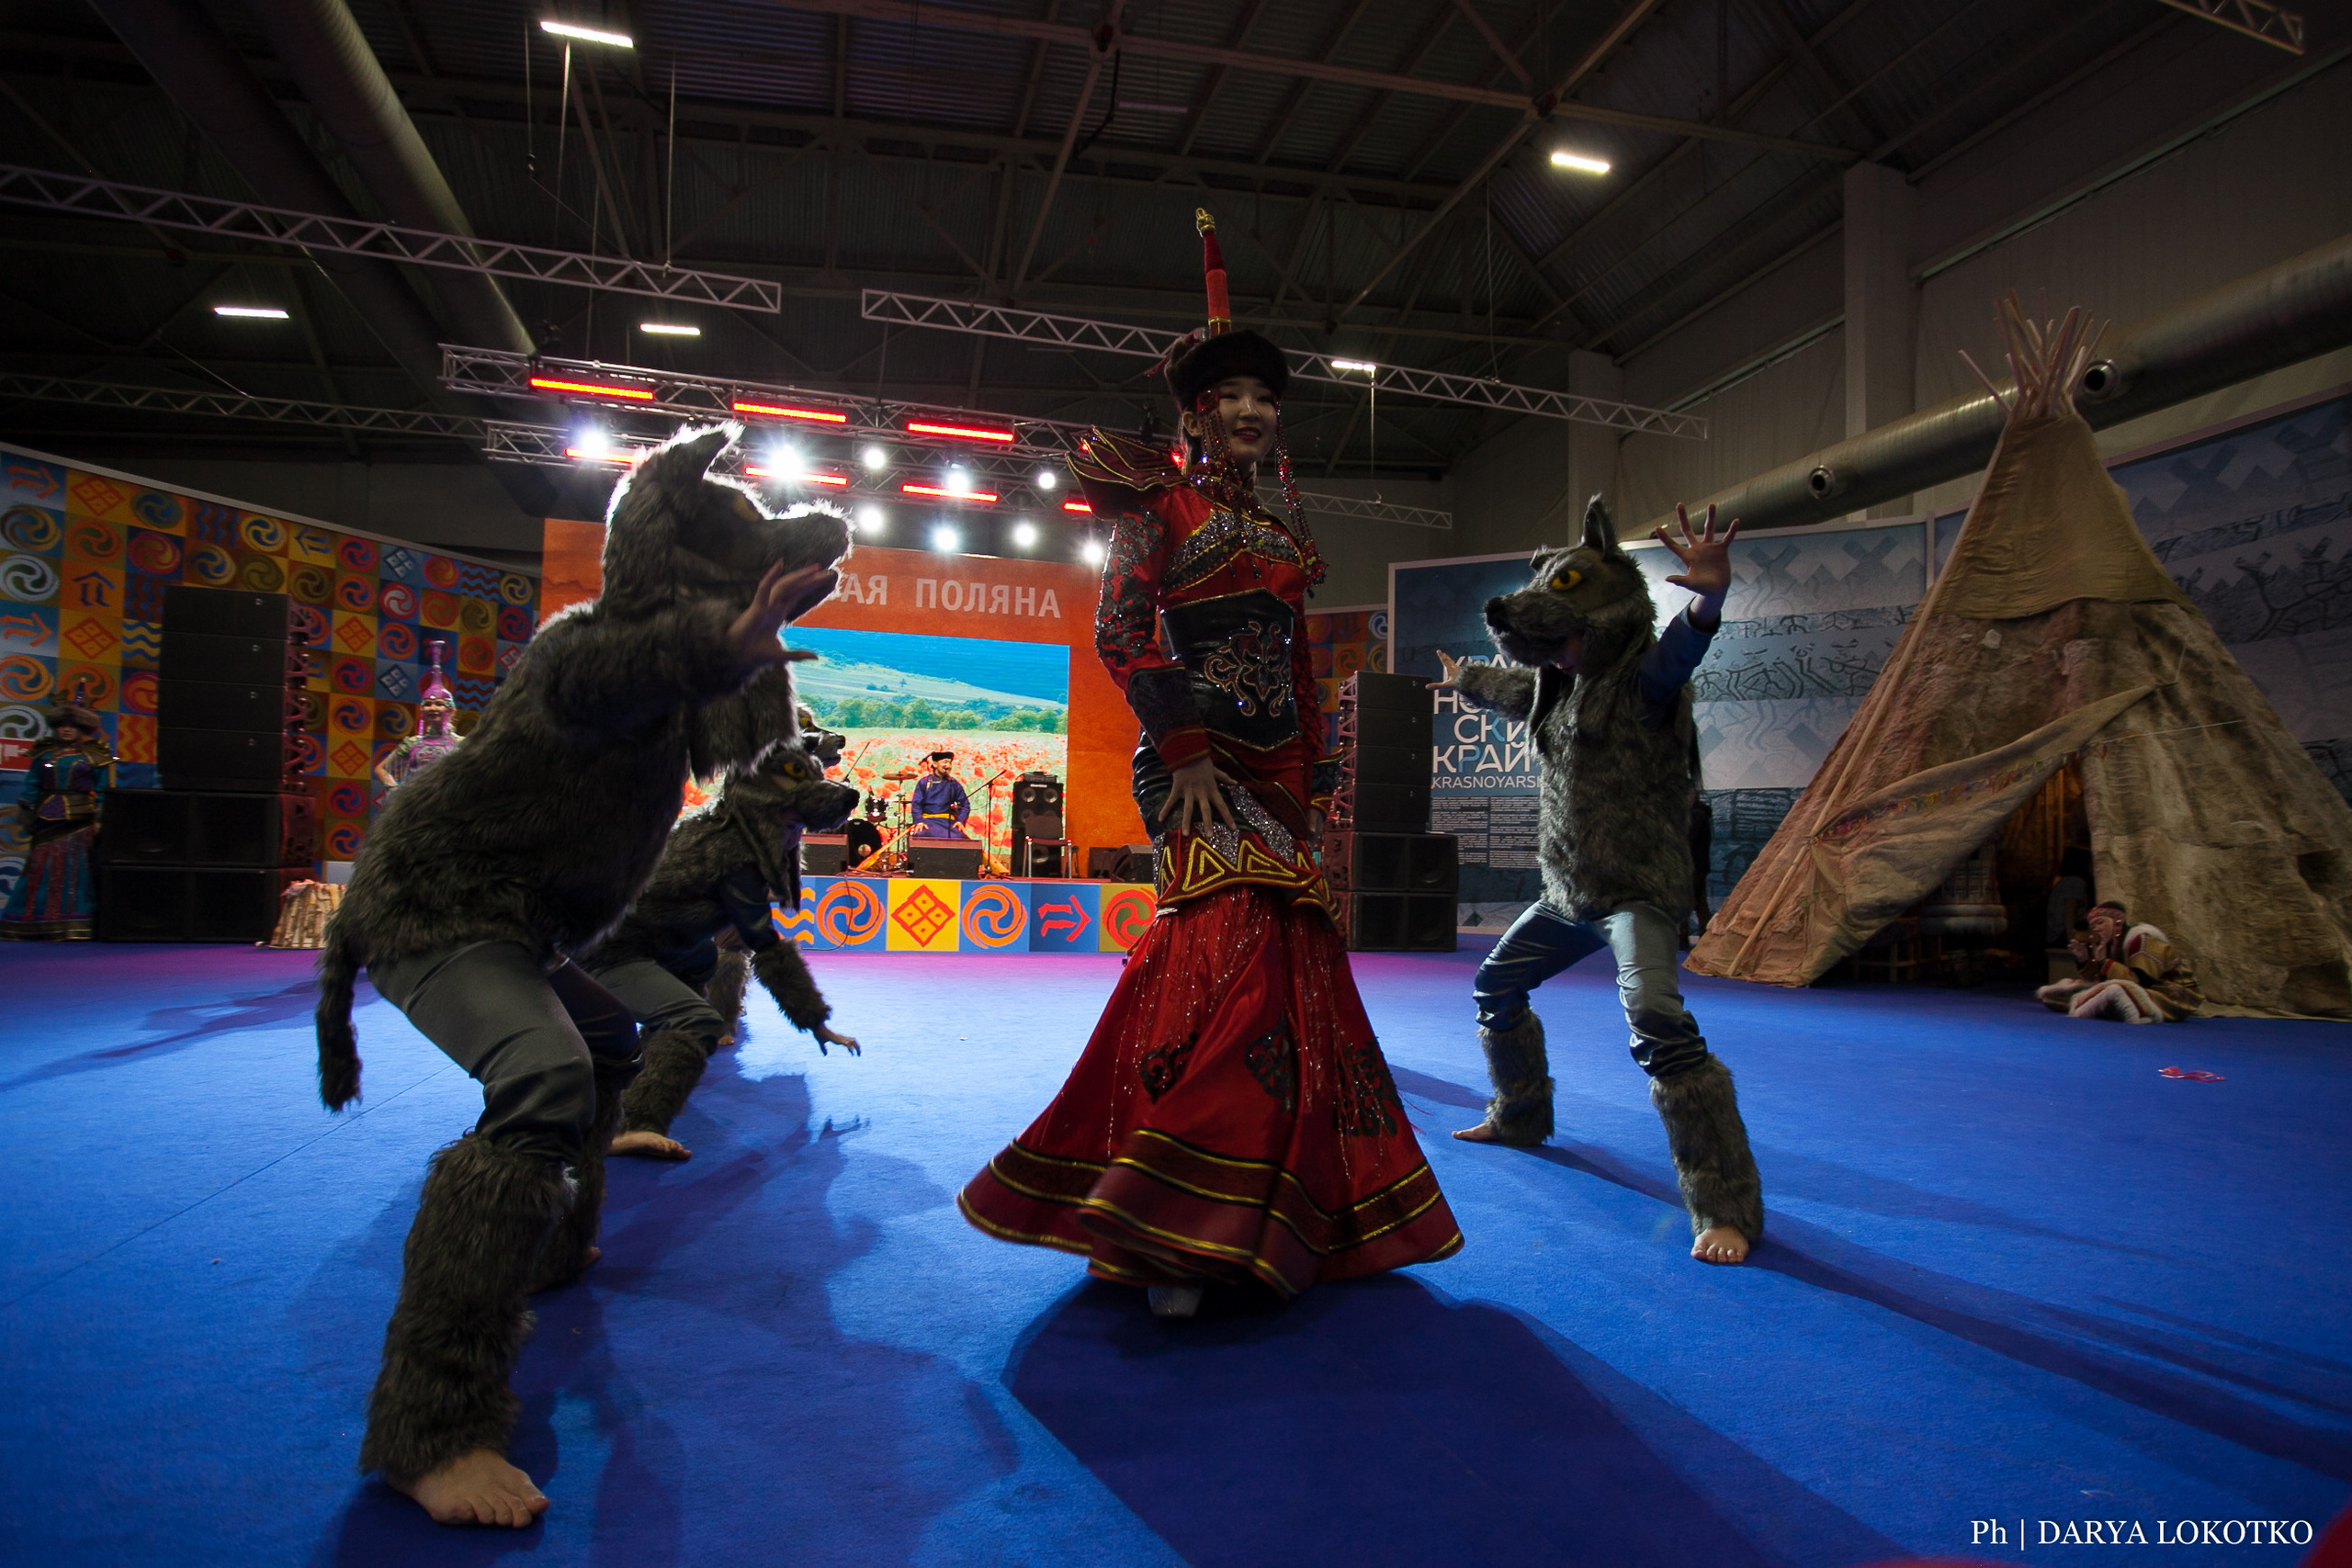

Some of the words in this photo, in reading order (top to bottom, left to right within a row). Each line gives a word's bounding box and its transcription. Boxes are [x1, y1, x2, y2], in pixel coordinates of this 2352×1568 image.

[841, 572, 888, 604] АЯ
[915, 578, 1061, 618] ПОЛЯНА
[1453, 714, 1527, 743] СКИ
[1432, 740, 1531, 774] КРАЙ
[1431, 775, 1542, 789] KRASNOYARS
